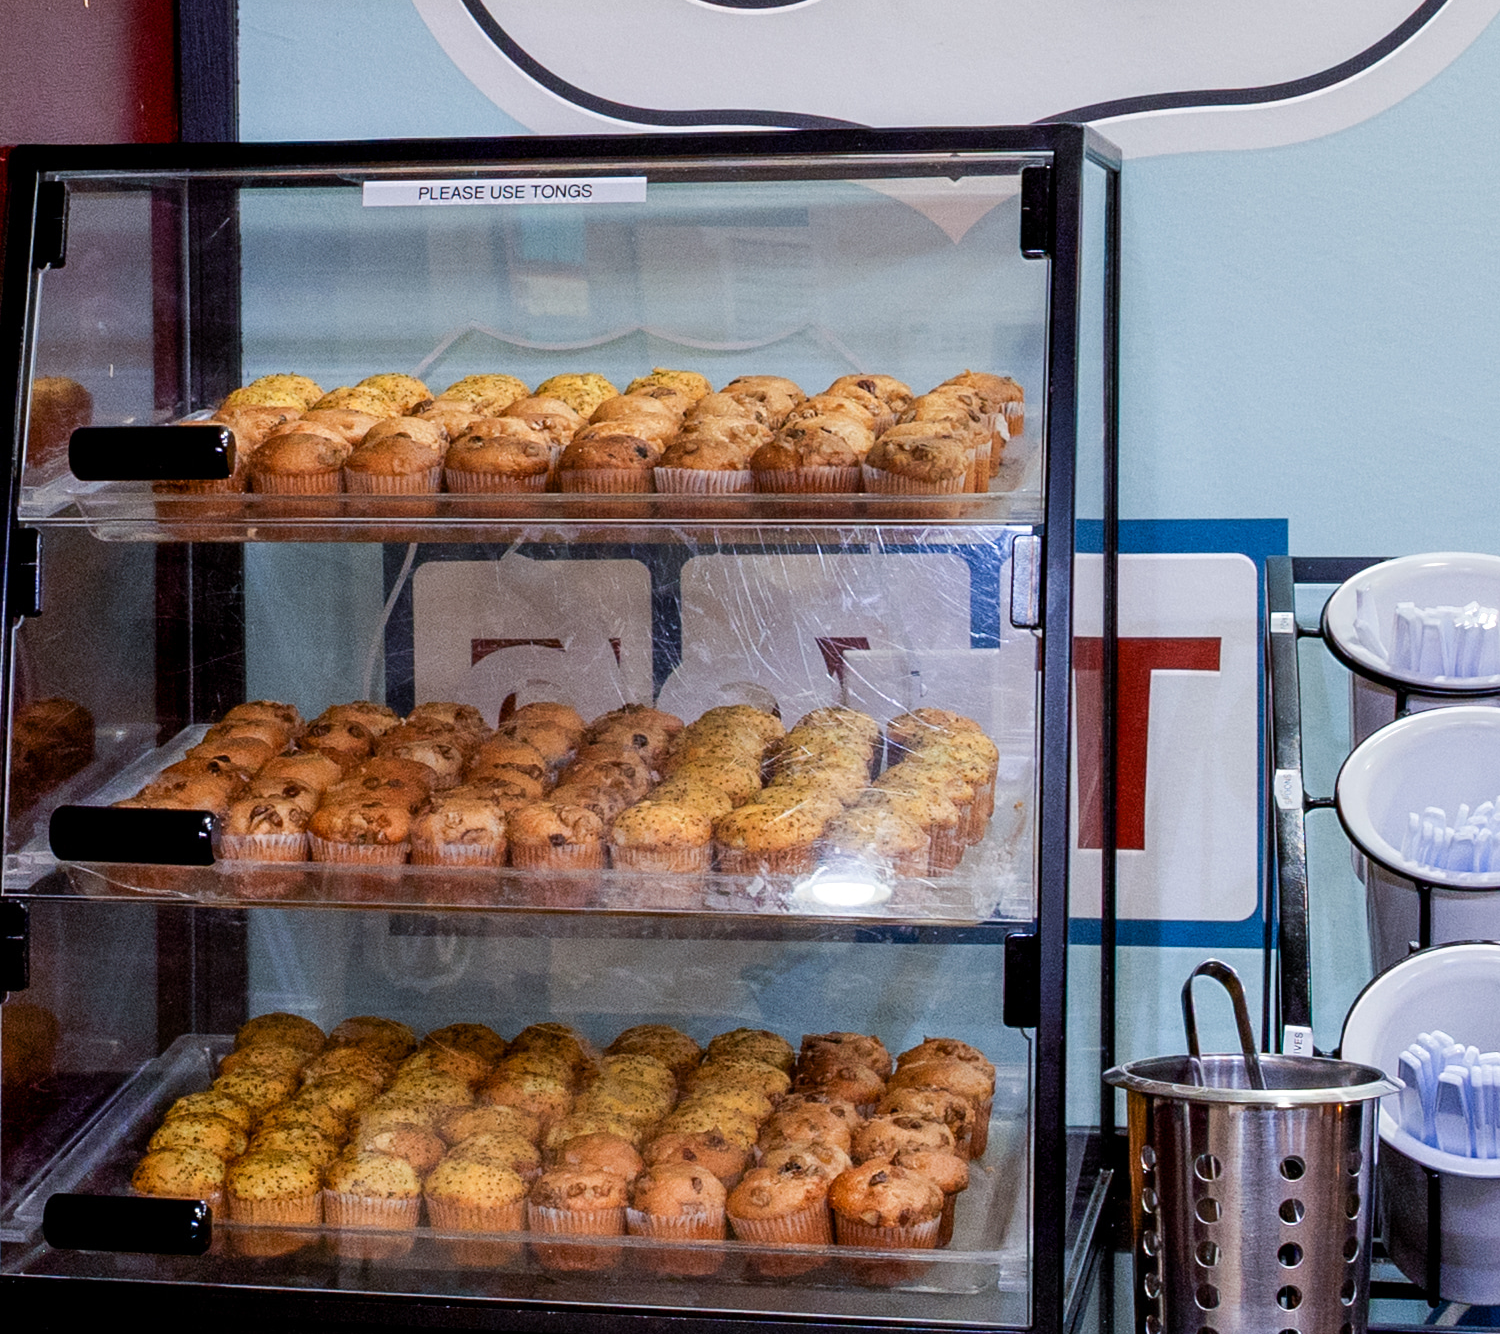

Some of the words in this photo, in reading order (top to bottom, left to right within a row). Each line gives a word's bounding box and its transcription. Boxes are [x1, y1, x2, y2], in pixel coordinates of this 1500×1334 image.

[418, 185, 486, 201] PLEASE
[490, 184, 526, 200] USE
[530, 183, 593, 199] TONGS
[1292, 1032, 1304, 1055] IVES
